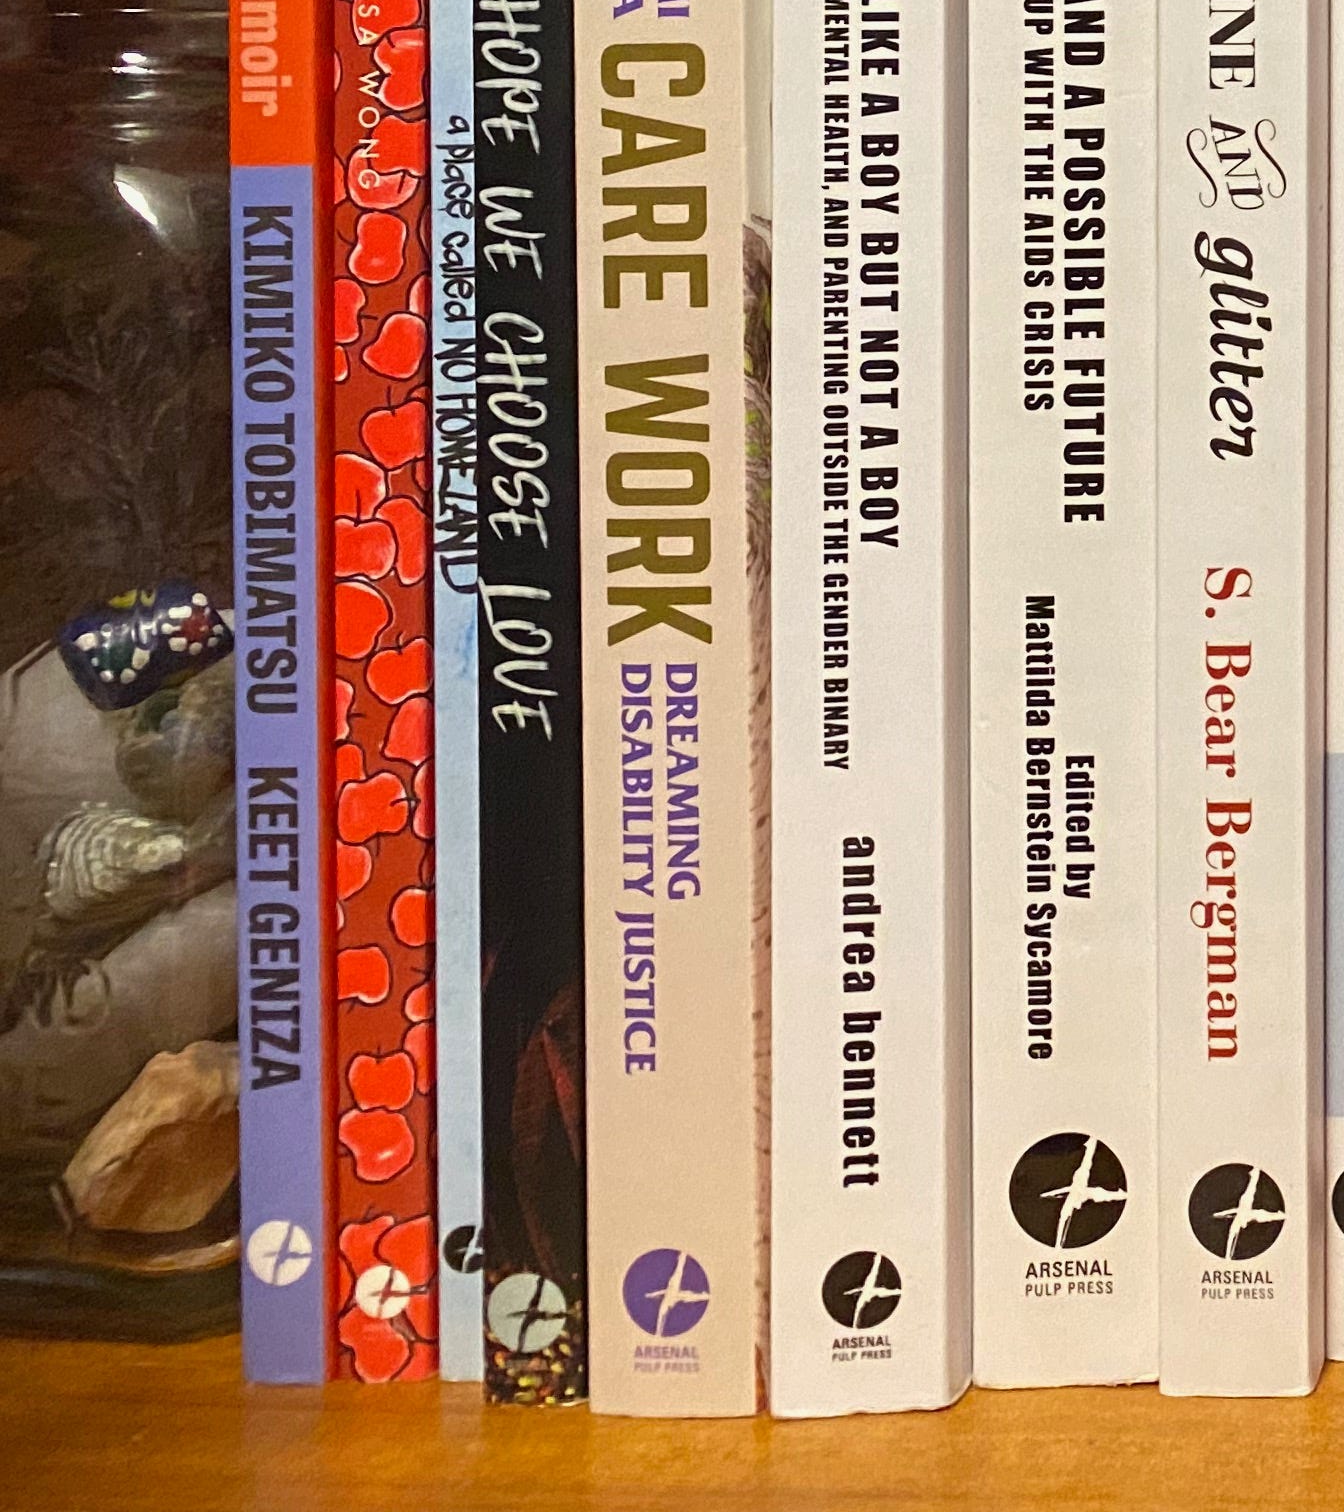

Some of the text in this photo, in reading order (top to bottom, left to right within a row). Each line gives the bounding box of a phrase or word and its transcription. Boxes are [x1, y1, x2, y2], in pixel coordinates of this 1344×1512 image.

[822, 95, 849, 190] HEALTH,
[1063, 84, 1104, 109] A
[1204, 118, 1269, 210] AND
[475, 187, 546, 280] WE
[822, 198, 849, 249] AND
[1063, 129, 1104, 341] POSSIBLE
[599, 43, 712, 644] CARE WORK
[822, 256, 849, 395] PARENTING
[1194, 232, 1270, 461] glitter
[243, 204, 294, 713] KIMIKO TOBIMATSU
[475, 312, 551, 544] CHOOSE
[822, 403, 849, 512] OUTSIDE
[1063, 358, 1104, 523] FUTURE
[822, 519, 849, 565] THE
[476, 581, 552, 738] LOVE
[824, 574, 848, 671] GENDER
[664, 663, 699, 900] DREAMING
[824, 679, 848, 770] BINARY
[618, 663, 658, 1074] DISABILITY JUSTICE
[1022, 595, 1056, 1060] Mattilda Bernstein Sycamore
[1061, 755, 1094, 898] Edited by
[248, 768, 299, 1090] KEET GENIZA
[842, 837, 882, 1188] andrea bennett
[1025, 1260, 1113, 1279] ARSENAL
[1025, 1280, 1114, 1297] PULP PRESS
